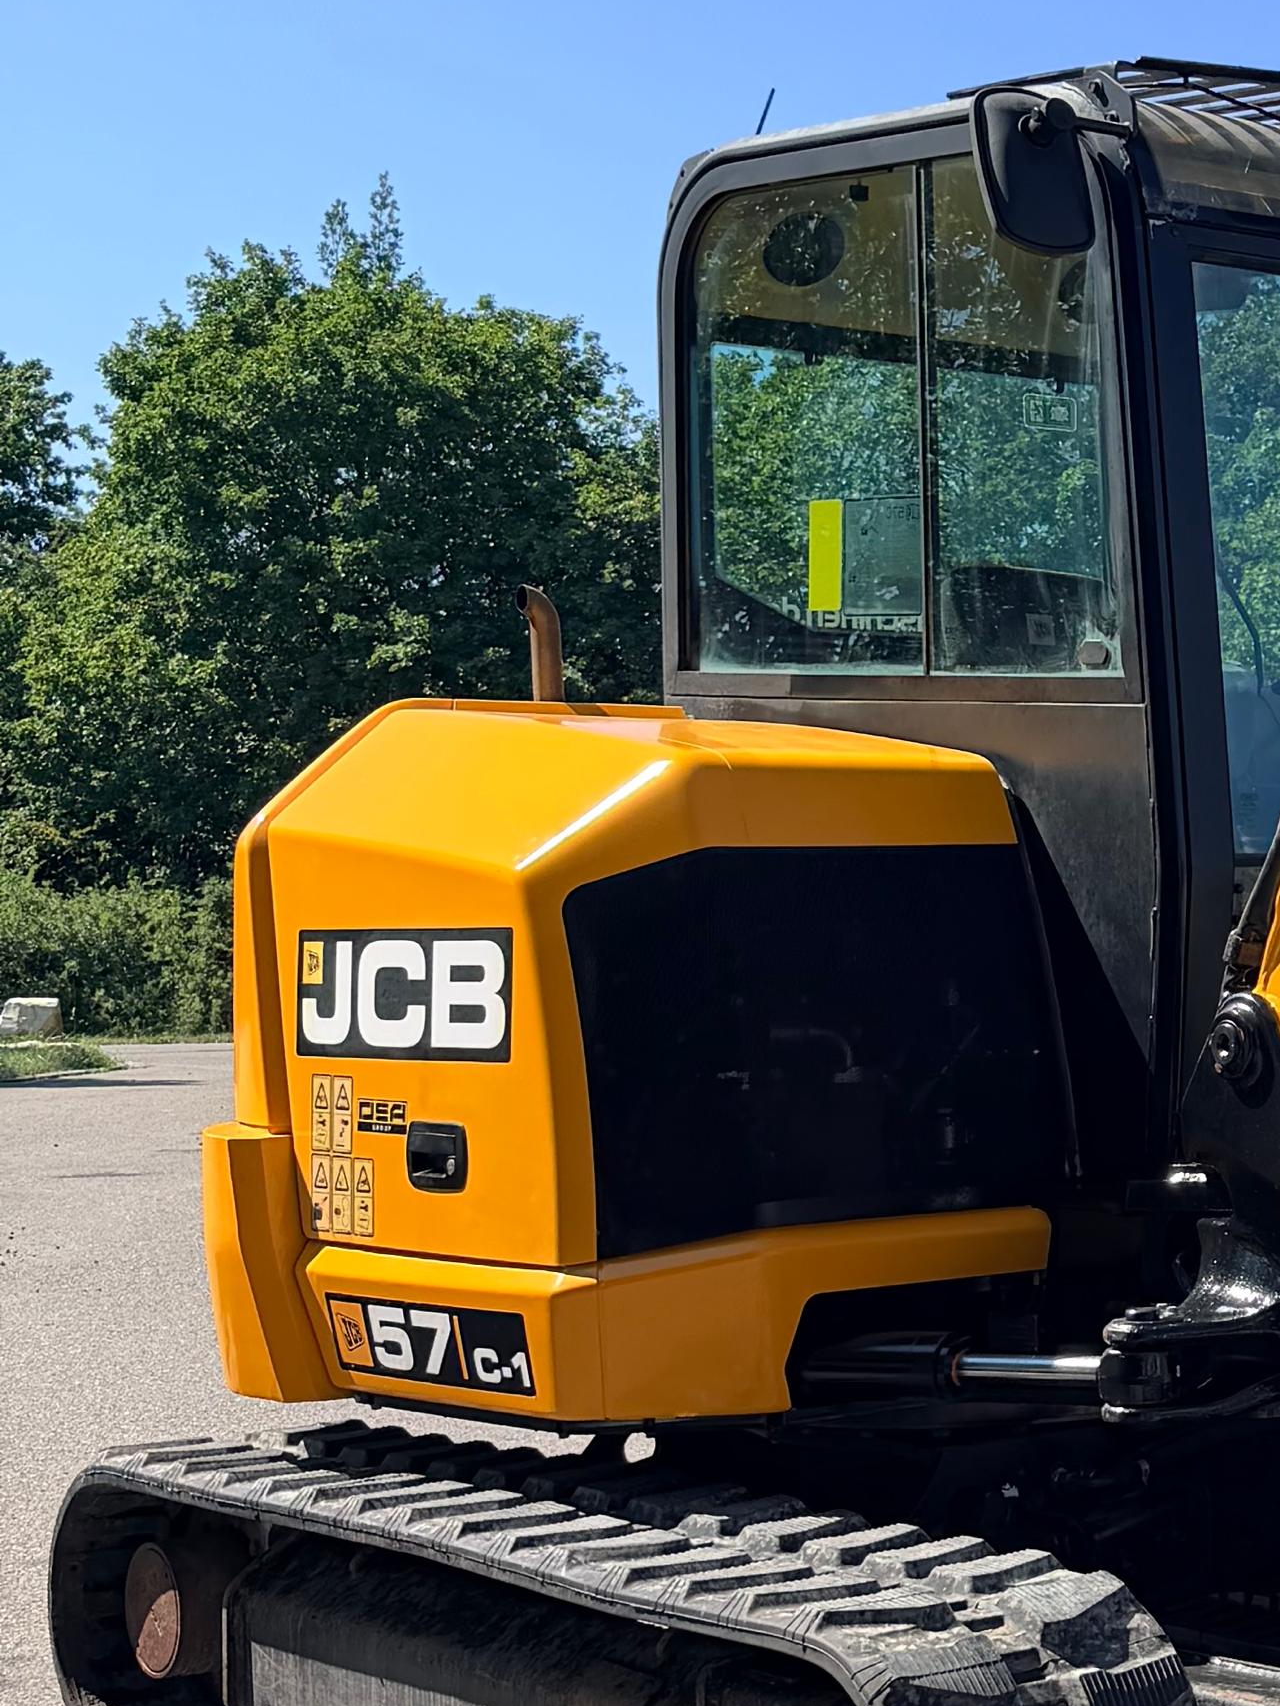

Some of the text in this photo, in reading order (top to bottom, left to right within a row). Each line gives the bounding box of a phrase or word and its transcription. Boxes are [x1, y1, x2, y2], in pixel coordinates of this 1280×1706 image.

[302, 940, 506, 1048] JCB
[367, 1304, 532, 1388] 57 C-1
